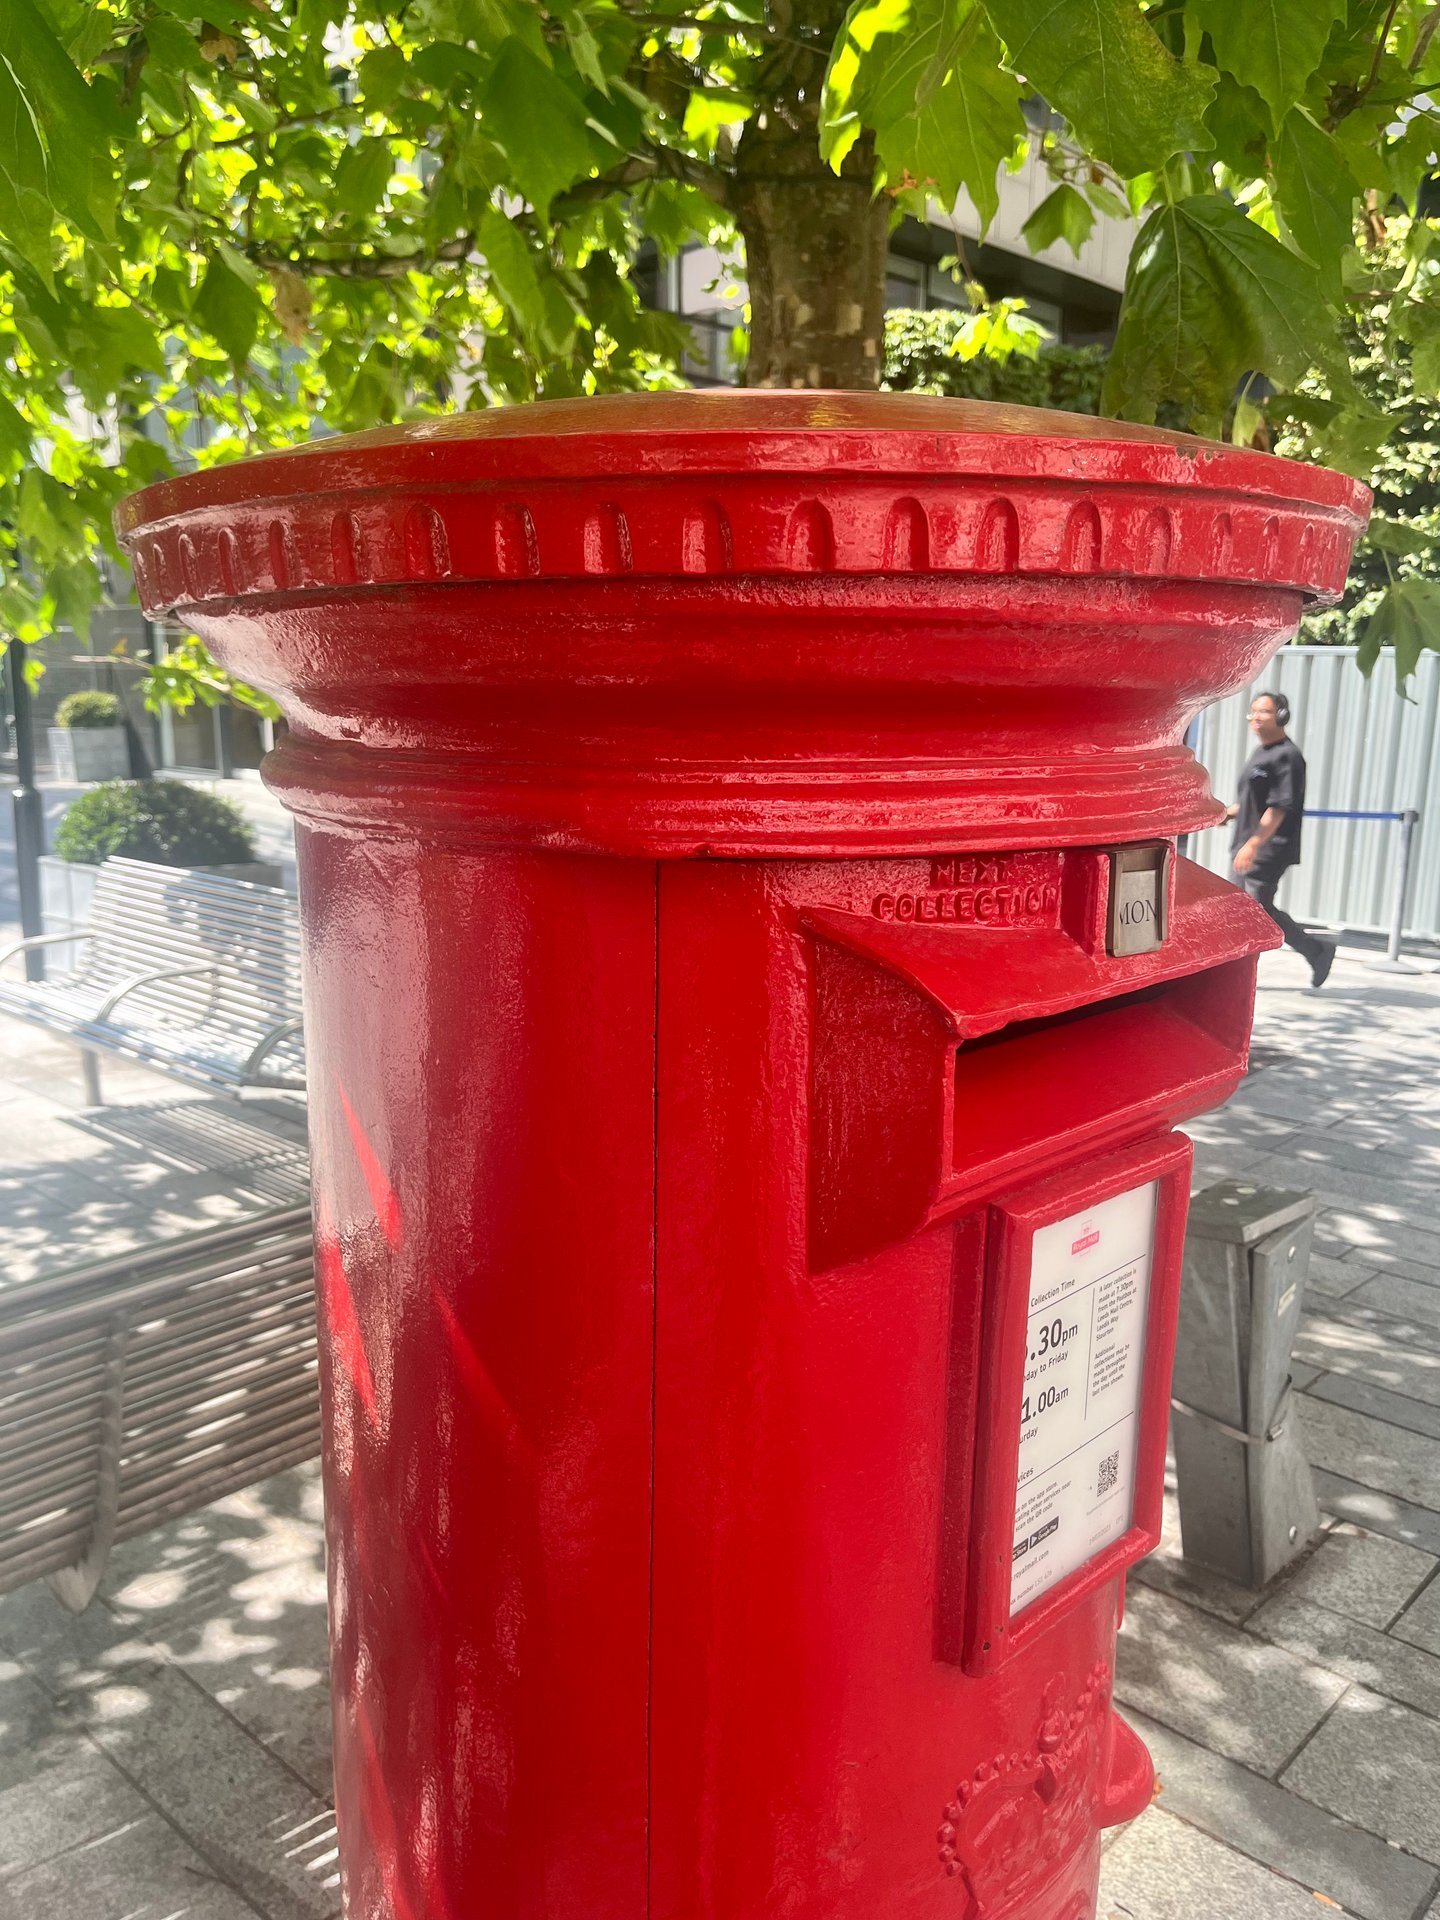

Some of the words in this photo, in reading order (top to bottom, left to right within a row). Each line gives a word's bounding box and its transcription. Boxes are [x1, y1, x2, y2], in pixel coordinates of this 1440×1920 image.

[929, 856, 1010, 886] NEXT
[872, 883, 1057, 922] COLLECTION
[1119, 899, 1158, 925] MON
[1113, 1271, 1133, 1285] collection
[1030, 1286, 1060, 1307] Collection
[1061, 1279, 1075, 1292] Time
[1098, 1293, 1110, 1303] made
[1097, 1302, 1109, 1313] from
[1097, 1311, 1110, 1323] Leeds
[1110, 1305, 1119, 1315] Mail
[1026, 1318, 1078, 1361] .30pm
[1039, 1363, 1047, 1373] to
[1048, 1349, 1069, 1367] Friday
[1093, 1353, 1115, 1369] collections
